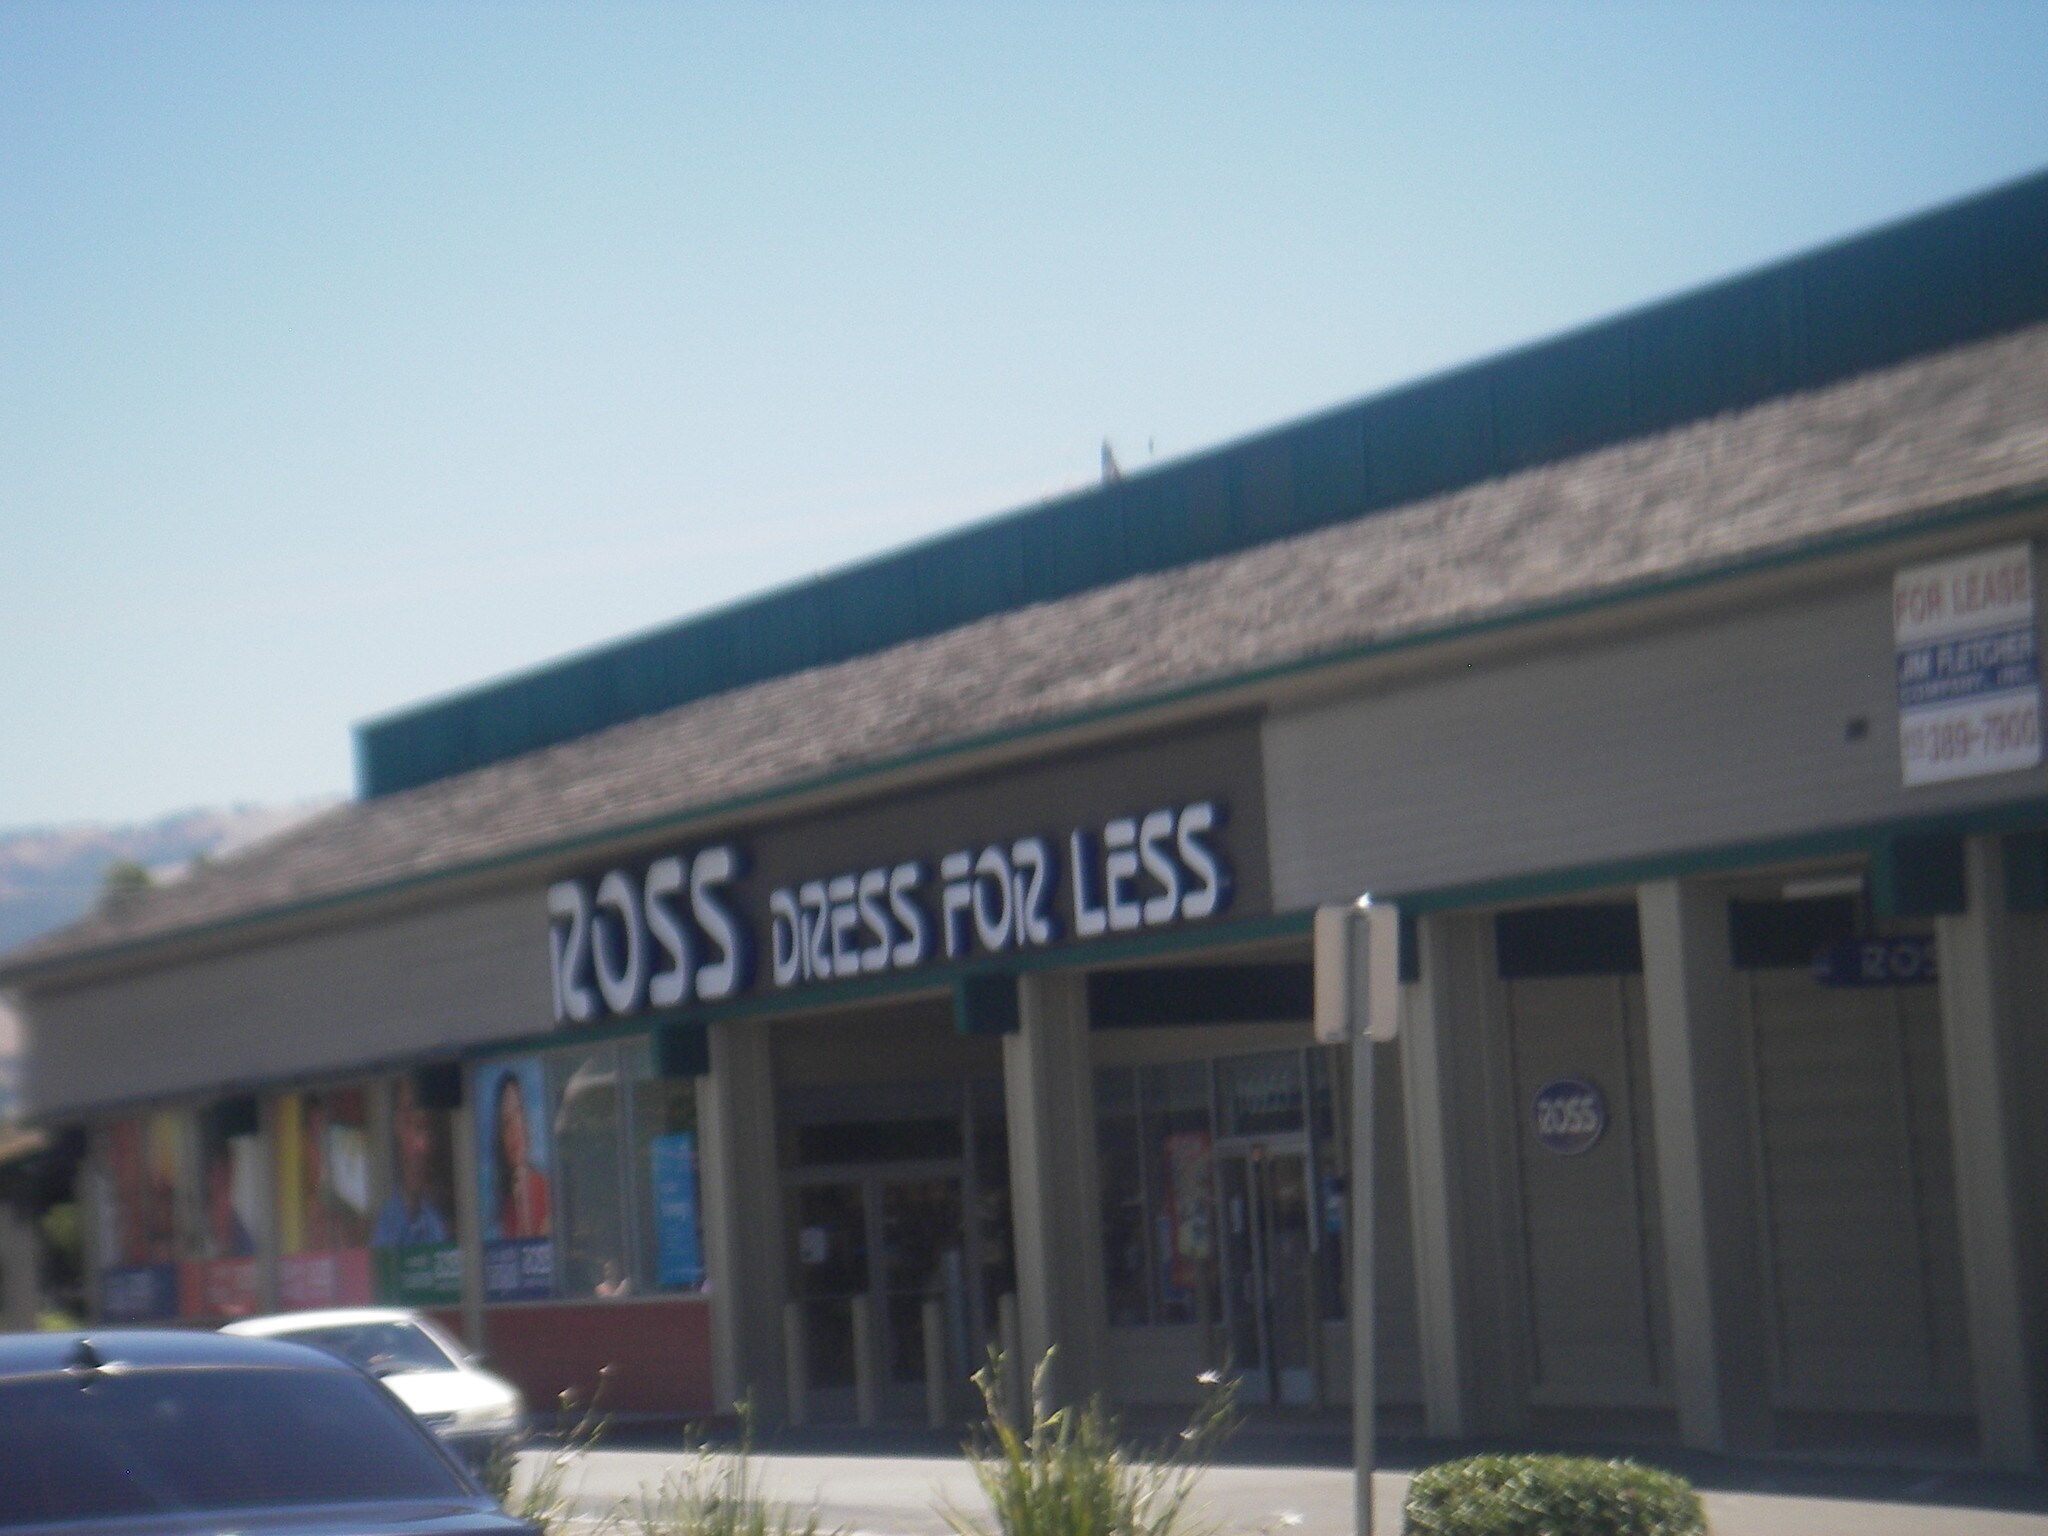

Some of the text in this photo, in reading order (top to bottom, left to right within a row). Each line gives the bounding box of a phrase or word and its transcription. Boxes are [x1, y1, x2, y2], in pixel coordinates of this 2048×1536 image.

[1895, 564, 2028, 623] FOR LEASE
[547, 803, 1220, 1023] ROSS DRESS FOR LESS
[1861, 944, 1938, 980] RO
[1537, 1095, 1597, 1136] ROSS
